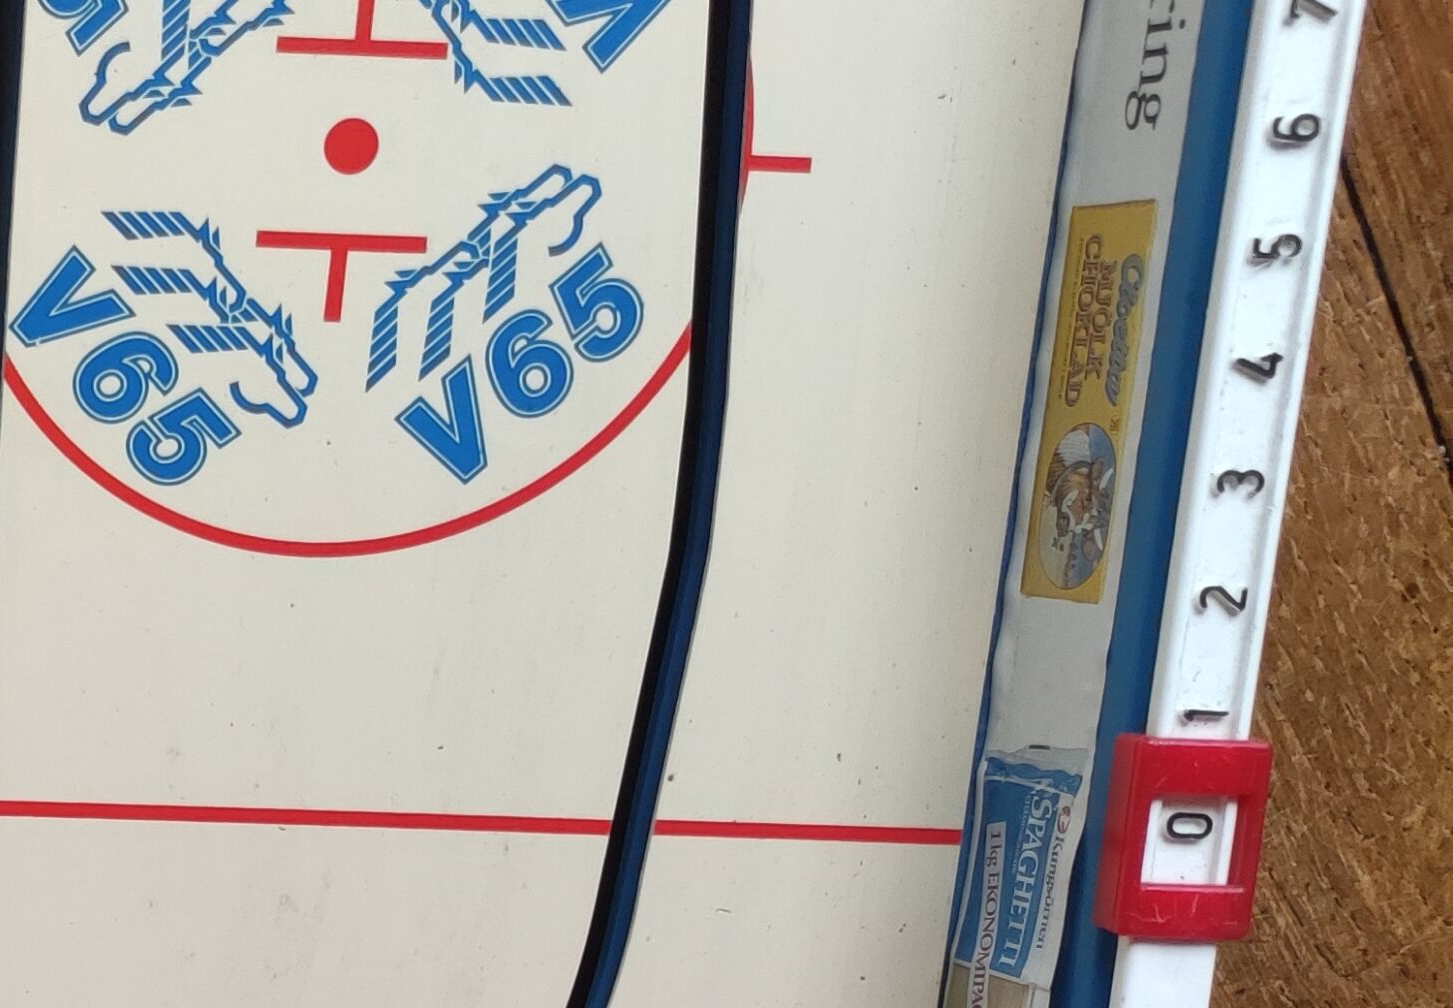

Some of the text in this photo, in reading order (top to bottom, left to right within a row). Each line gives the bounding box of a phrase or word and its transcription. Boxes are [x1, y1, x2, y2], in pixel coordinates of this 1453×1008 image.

[1270, 112, 1322, 151] 6
[1249, 234, 1302, 267] 5
[9, 245, 242, 486] V65
[394, 241, 645, 484] V65
[1233, 352, 1284, 385] 4
[1213, 469, 1265, 498] 3
[1195, 584, 1248, 615] 2
[1182, 708, 1229, 723] 1
[1166, 811, 1213, 843] 0
[1000, 793, 1052, 968] SPAGHETTI
